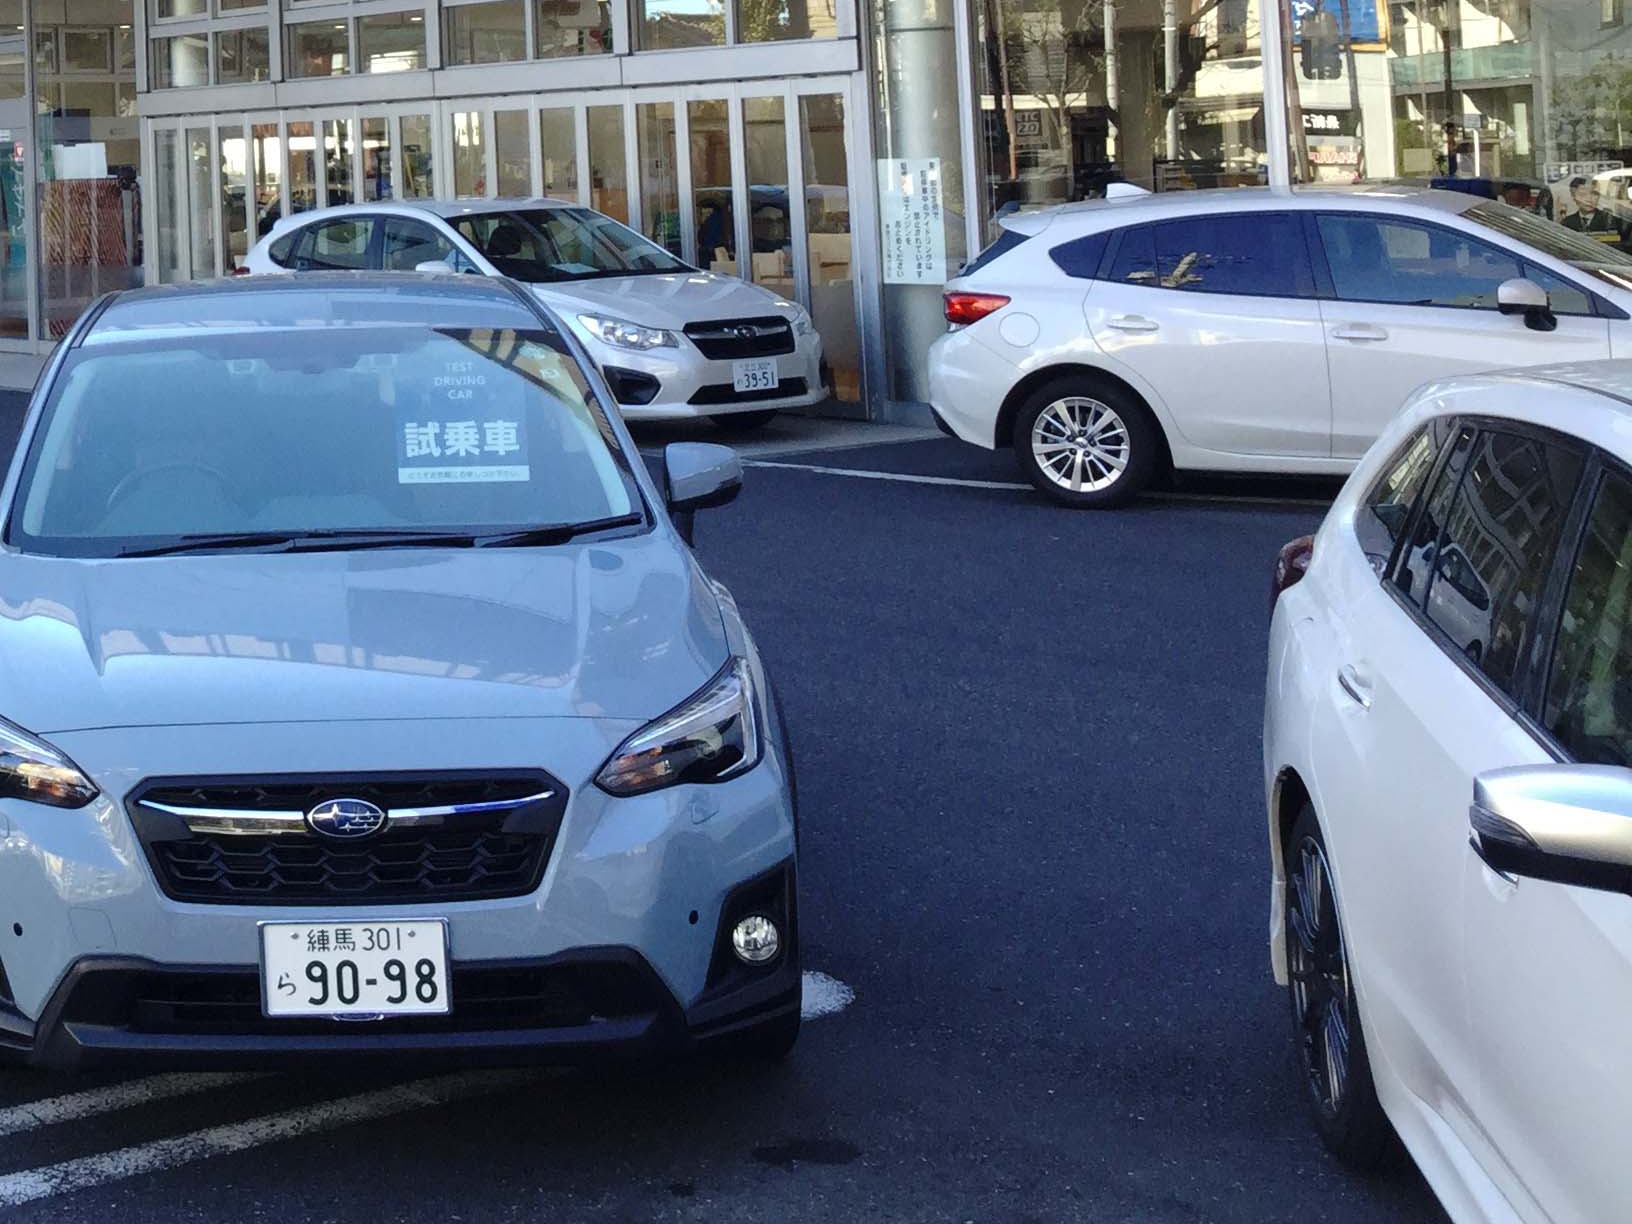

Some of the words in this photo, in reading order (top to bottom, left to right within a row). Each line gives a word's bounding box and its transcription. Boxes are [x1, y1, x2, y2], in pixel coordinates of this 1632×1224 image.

[434, 376, 486, 386] DRIVING
[447, 390, 473, 399] CAR
[404, 420, 520, 458] 試乗車
[305, 958, 438, 1005] 90-98
